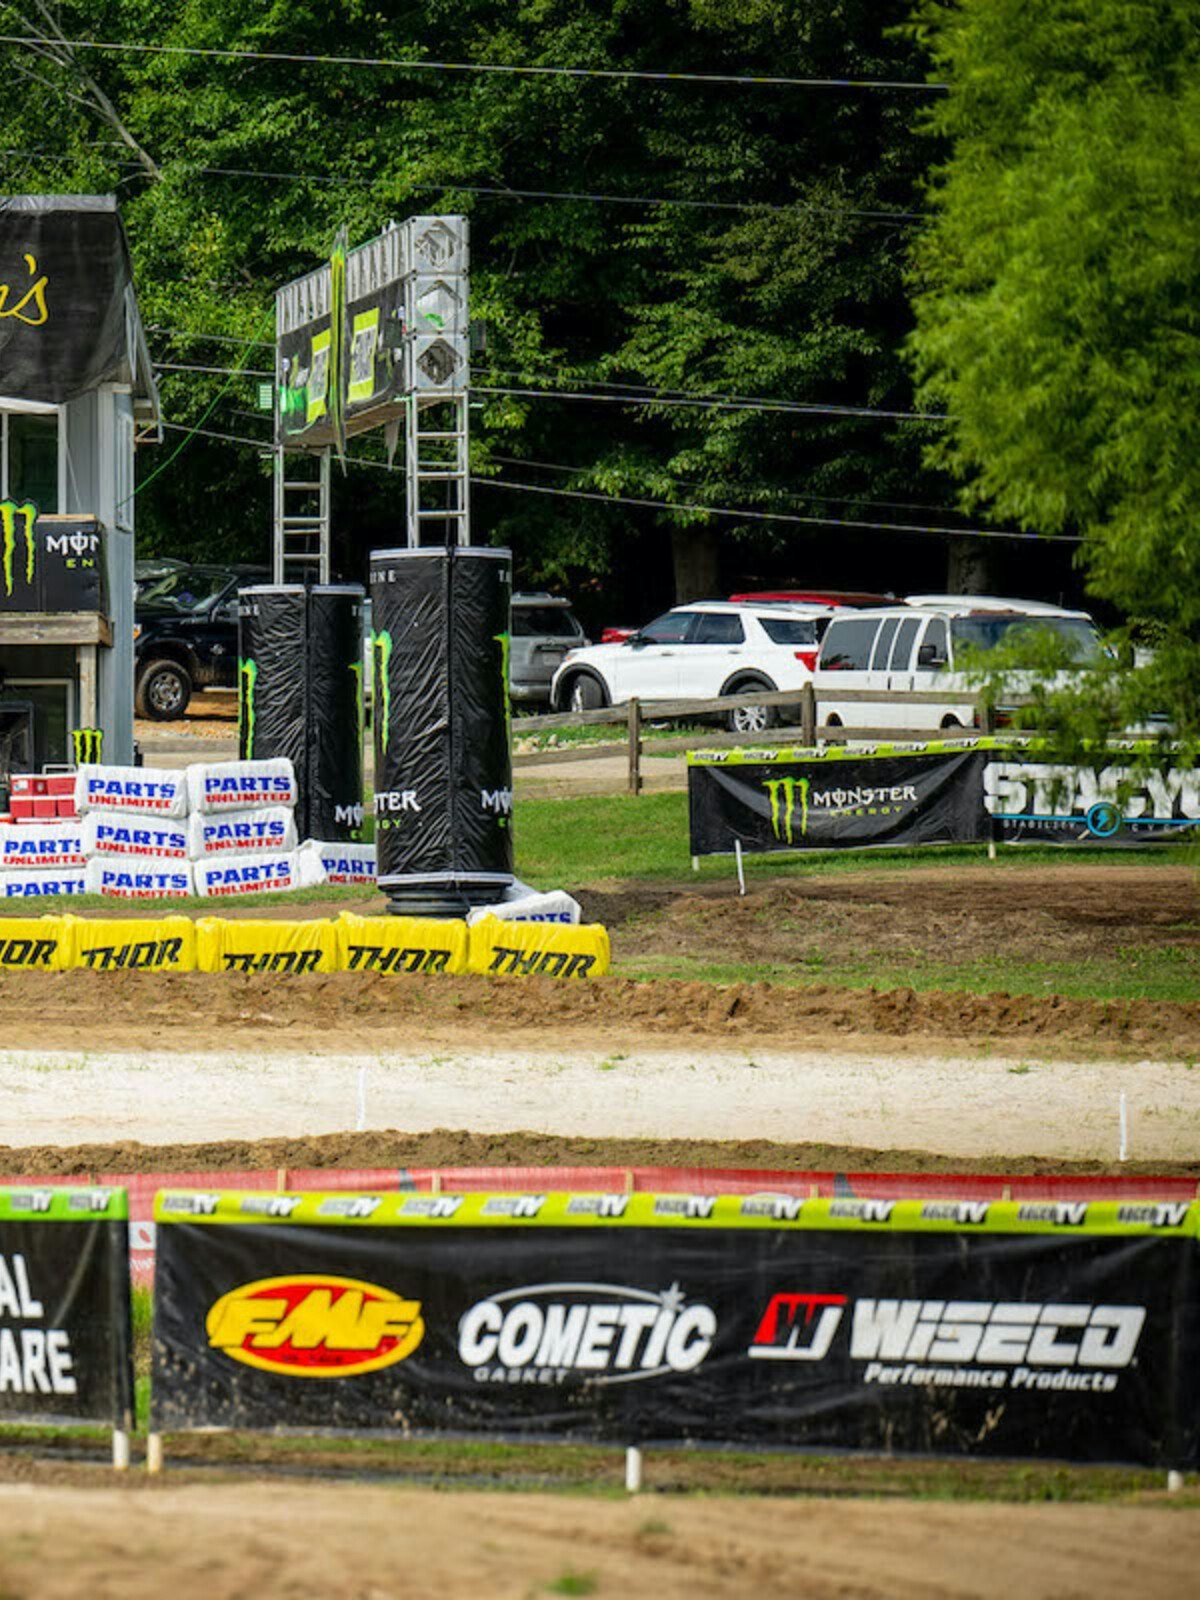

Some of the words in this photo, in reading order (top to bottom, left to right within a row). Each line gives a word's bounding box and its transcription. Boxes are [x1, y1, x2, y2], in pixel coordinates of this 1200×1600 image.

[89, 779, 176, 799] PARTS
[205, 776, 291, 793] PARTS
[813, 786, 918, 808] MONSTER
[829, 805, 903, 816] ENERGY
[97, 825, 186, 848] PARTS
[203, 821, 285, 841] PARTS
[96, 841, 185, 859] UNLIMITED
[205, 861, 291, 885] PARTS
[322, 859, 376, 875] PART
[102, 871, 188, 889] PARTS
[207, 877, 291, 897] UNLIMITED
[81, 937, 183, 968] THOR
[223, 949, 323, 974] THOR
[347, 945, 451, 973] THOR
[490, 946, 596, 979] THOR
[209, 1289, 422, 1350] FMF
[459, 1295, 717, 1372] COMETIC
[474, 1368, 568, 1384] GASKET
[864, 1362, 1007, 1388] Performance
[1011, 1367, 1118, 1393] Products
